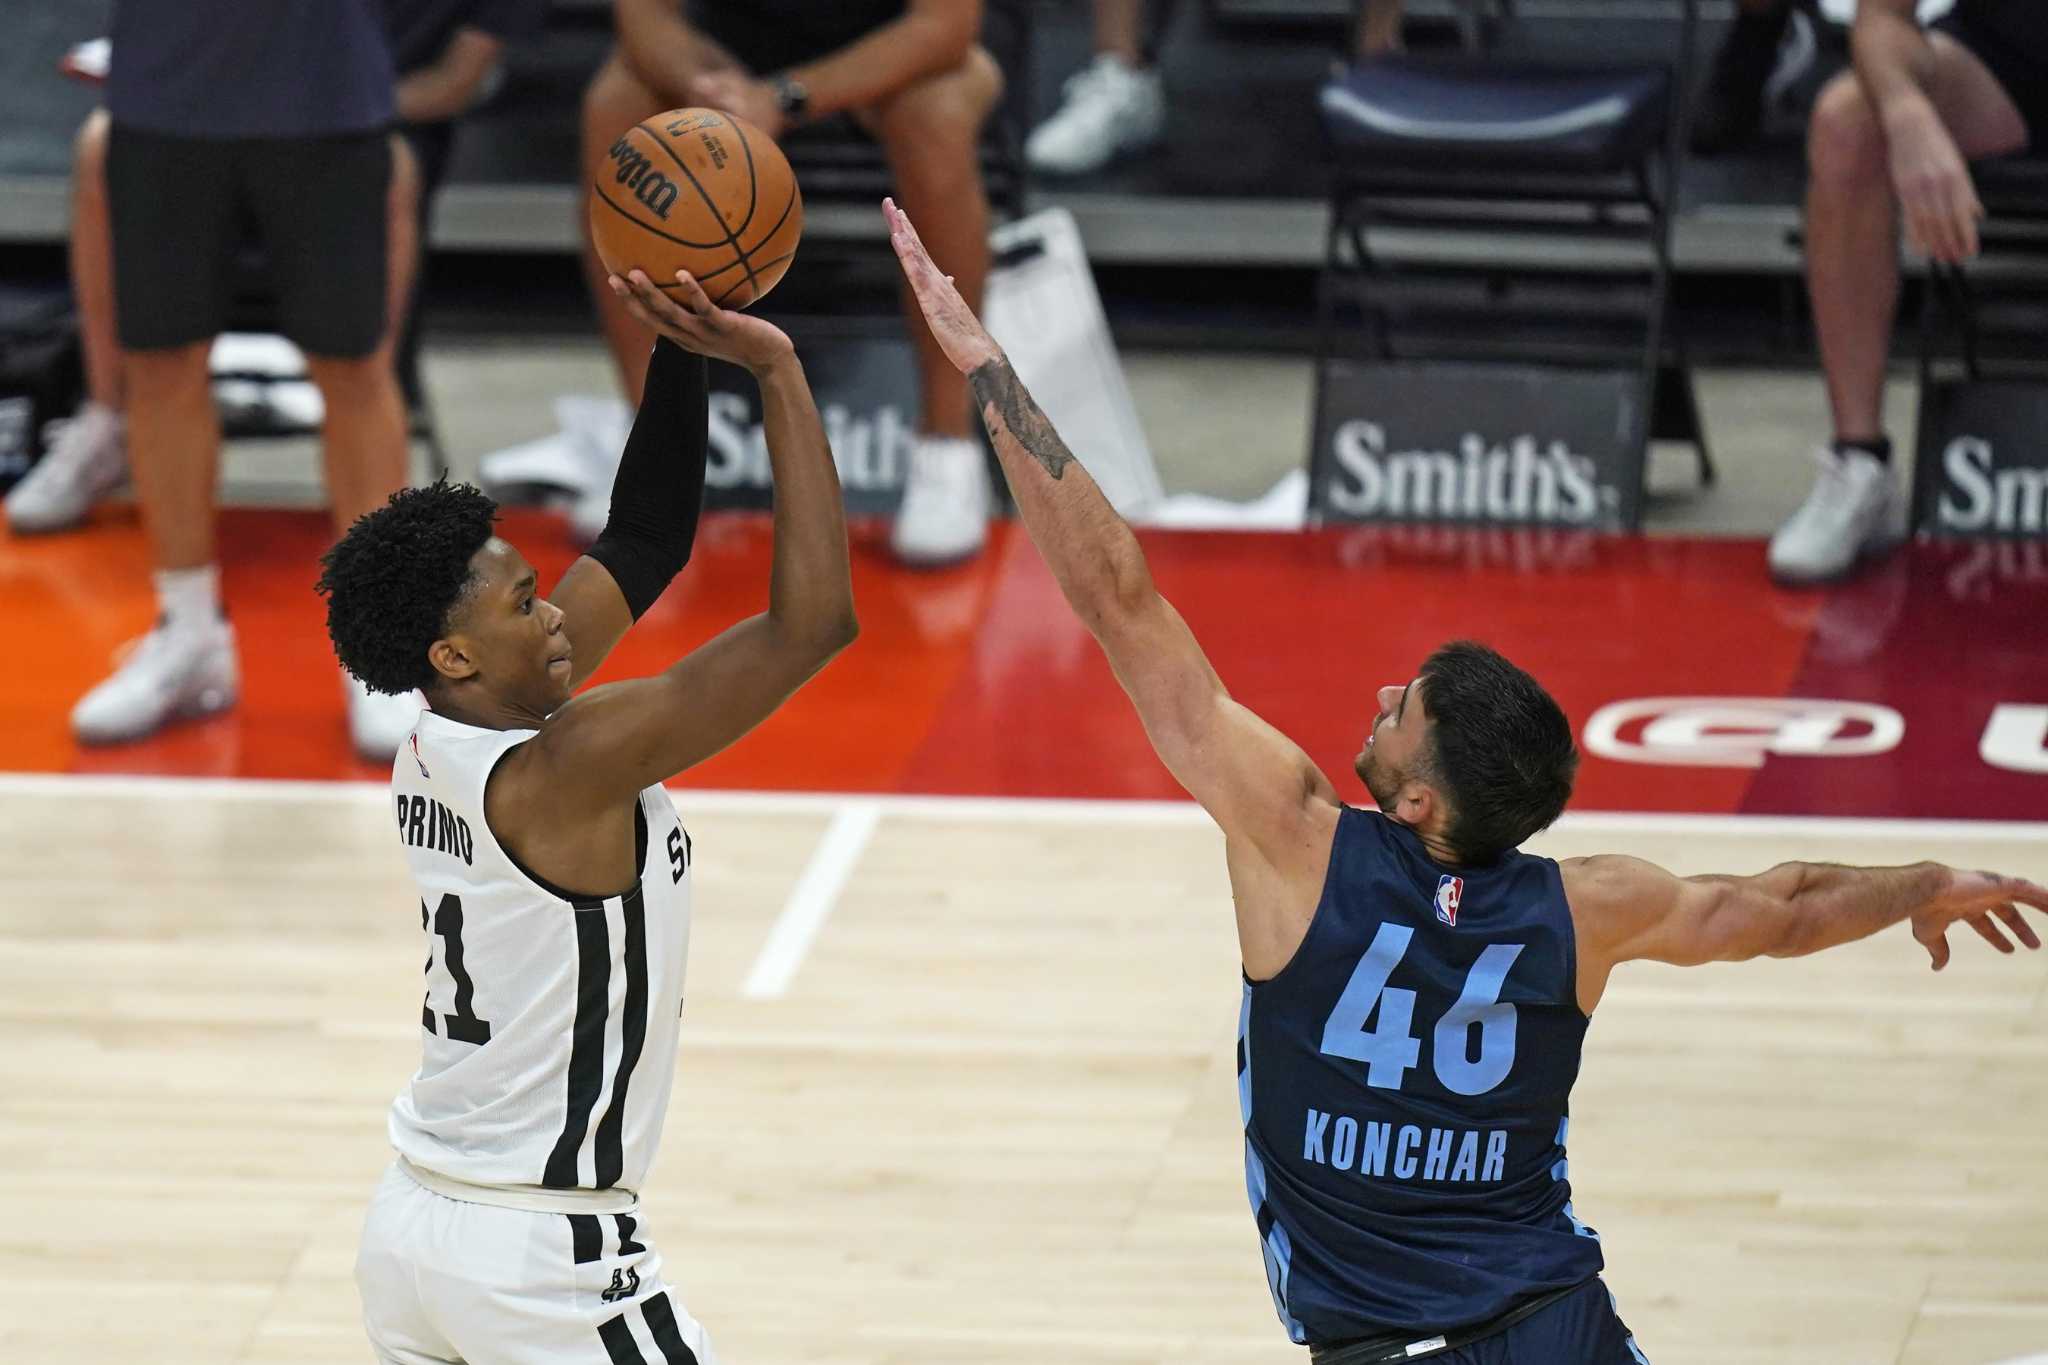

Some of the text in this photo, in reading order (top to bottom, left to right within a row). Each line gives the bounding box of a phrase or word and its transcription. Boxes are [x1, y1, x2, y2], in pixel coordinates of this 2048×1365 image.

[609, 137, 678, 221] Wilson
[397, 794, 473, 867] PRIMO
[1320, 921, 1526, 1096] 46
[1303, 1108, 1508, 1181] KONCHAR
